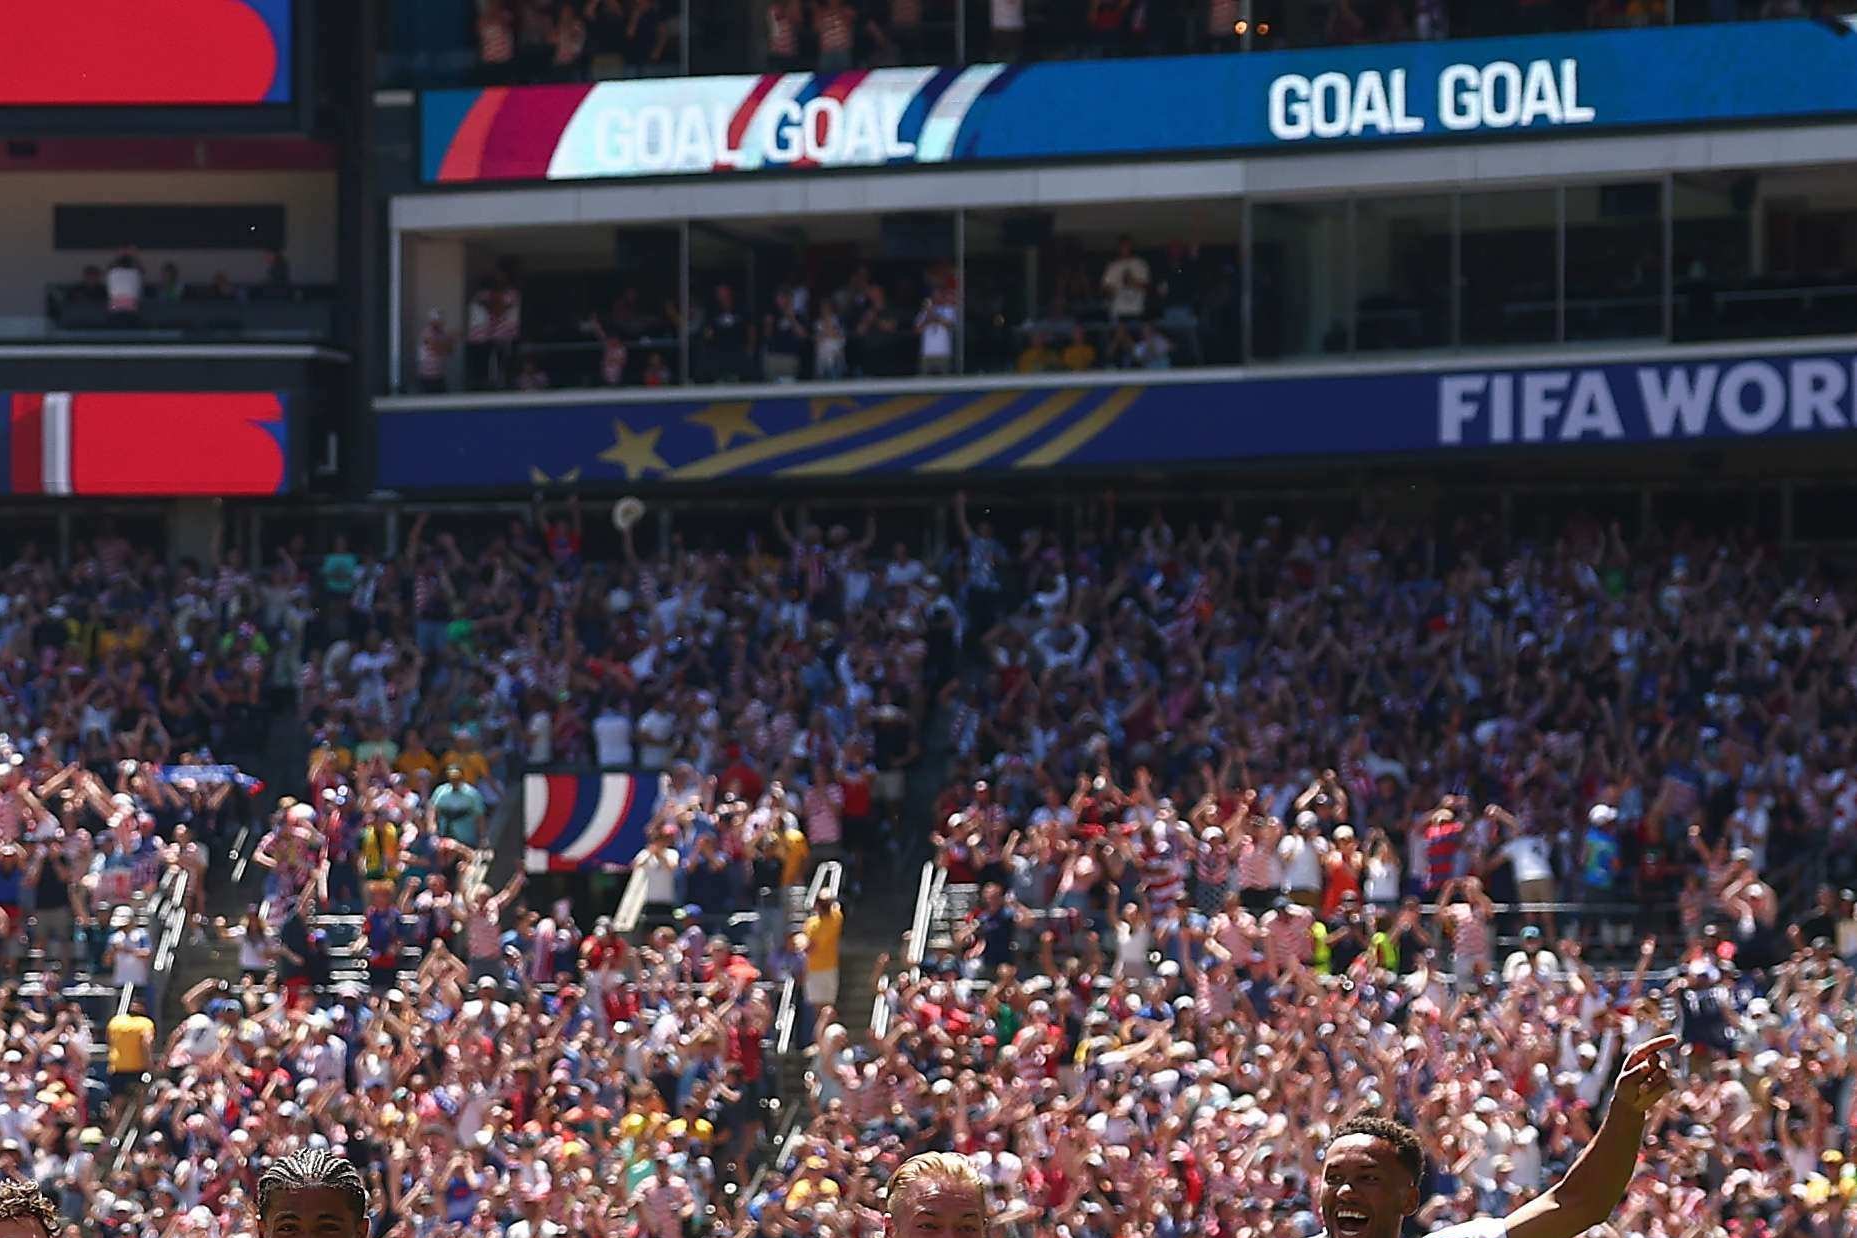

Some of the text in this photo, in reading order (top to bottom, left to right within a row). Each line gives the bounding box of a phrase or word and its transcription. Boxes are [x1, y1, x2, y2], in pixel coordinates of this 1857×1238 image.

[596, 96, 917, 170] GOAL GOAL
[1269, 58, 1595, 140] GOAL GOAL
[1438, 358, 1857, 444] FIFA WOR
